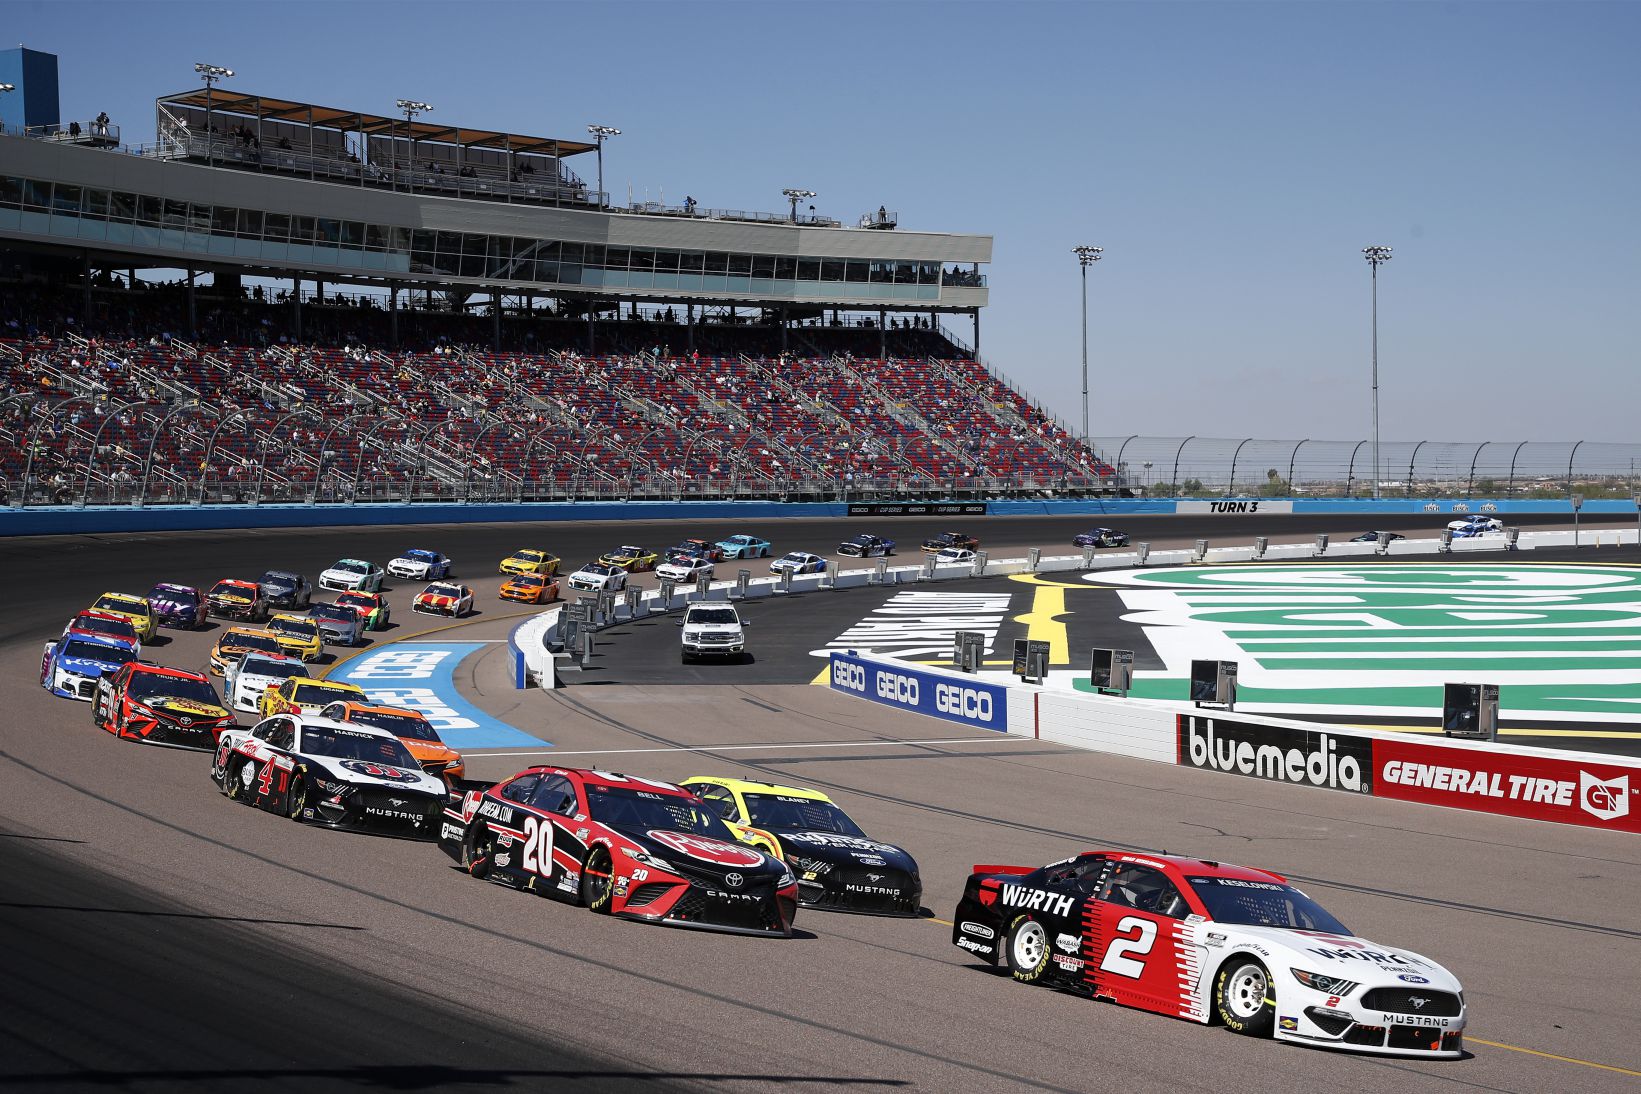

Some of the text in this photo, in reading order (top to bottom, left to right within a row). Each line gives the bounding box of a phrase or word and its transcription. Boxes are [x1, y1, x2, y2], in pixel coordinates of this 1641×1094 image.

[1210, 502, 1258, 513] TURN 3
[834, 659, 866, 692] GEICO
[876, 671, 919, 706] GEICO
[935, 683, 993, 722] GEICO
[377, 713, 405, 721] HAMLIN
[334, 729, 375, 740] HARVICK
[1189, 716, 1361, 792] bluemedia
[258, 754, 277, 796] 4
[1382, 760, 1504, 798] GENERAL
[1508, 774, 1577, 807] TIRE
[637, 791, 664, 800] BELL
[776, 796, 810, 804] BLANEY
[365, 807, 424, 821] MUSTANG
[477, 801, 513, 823] RHEEM.COM
[522, 816, 554, 879] 20
[632, 868, 649, 881] 20
[801, 871, 818, 880] 12
[846, 884, 900, 896] MUSTANG
[1217, 878, 1284, 892] KESELOWSKI
[707, 890, 762, 901] CAMRY
[1002, 883, 1076, 917] WÜRTH
[964, 922, 992, 937] FREIGHTLINER
[956, 936, 993, 954] Snap-on
[1100, 915, 1158, 980] 2
[1052, 953, 1084, 968] DISCOUNT
[1061, 963, 1077, 972] TIRE
[1325, 996, 1341, 1007] 2
[1383, 1014, 1449, 1027] MUSTANG
